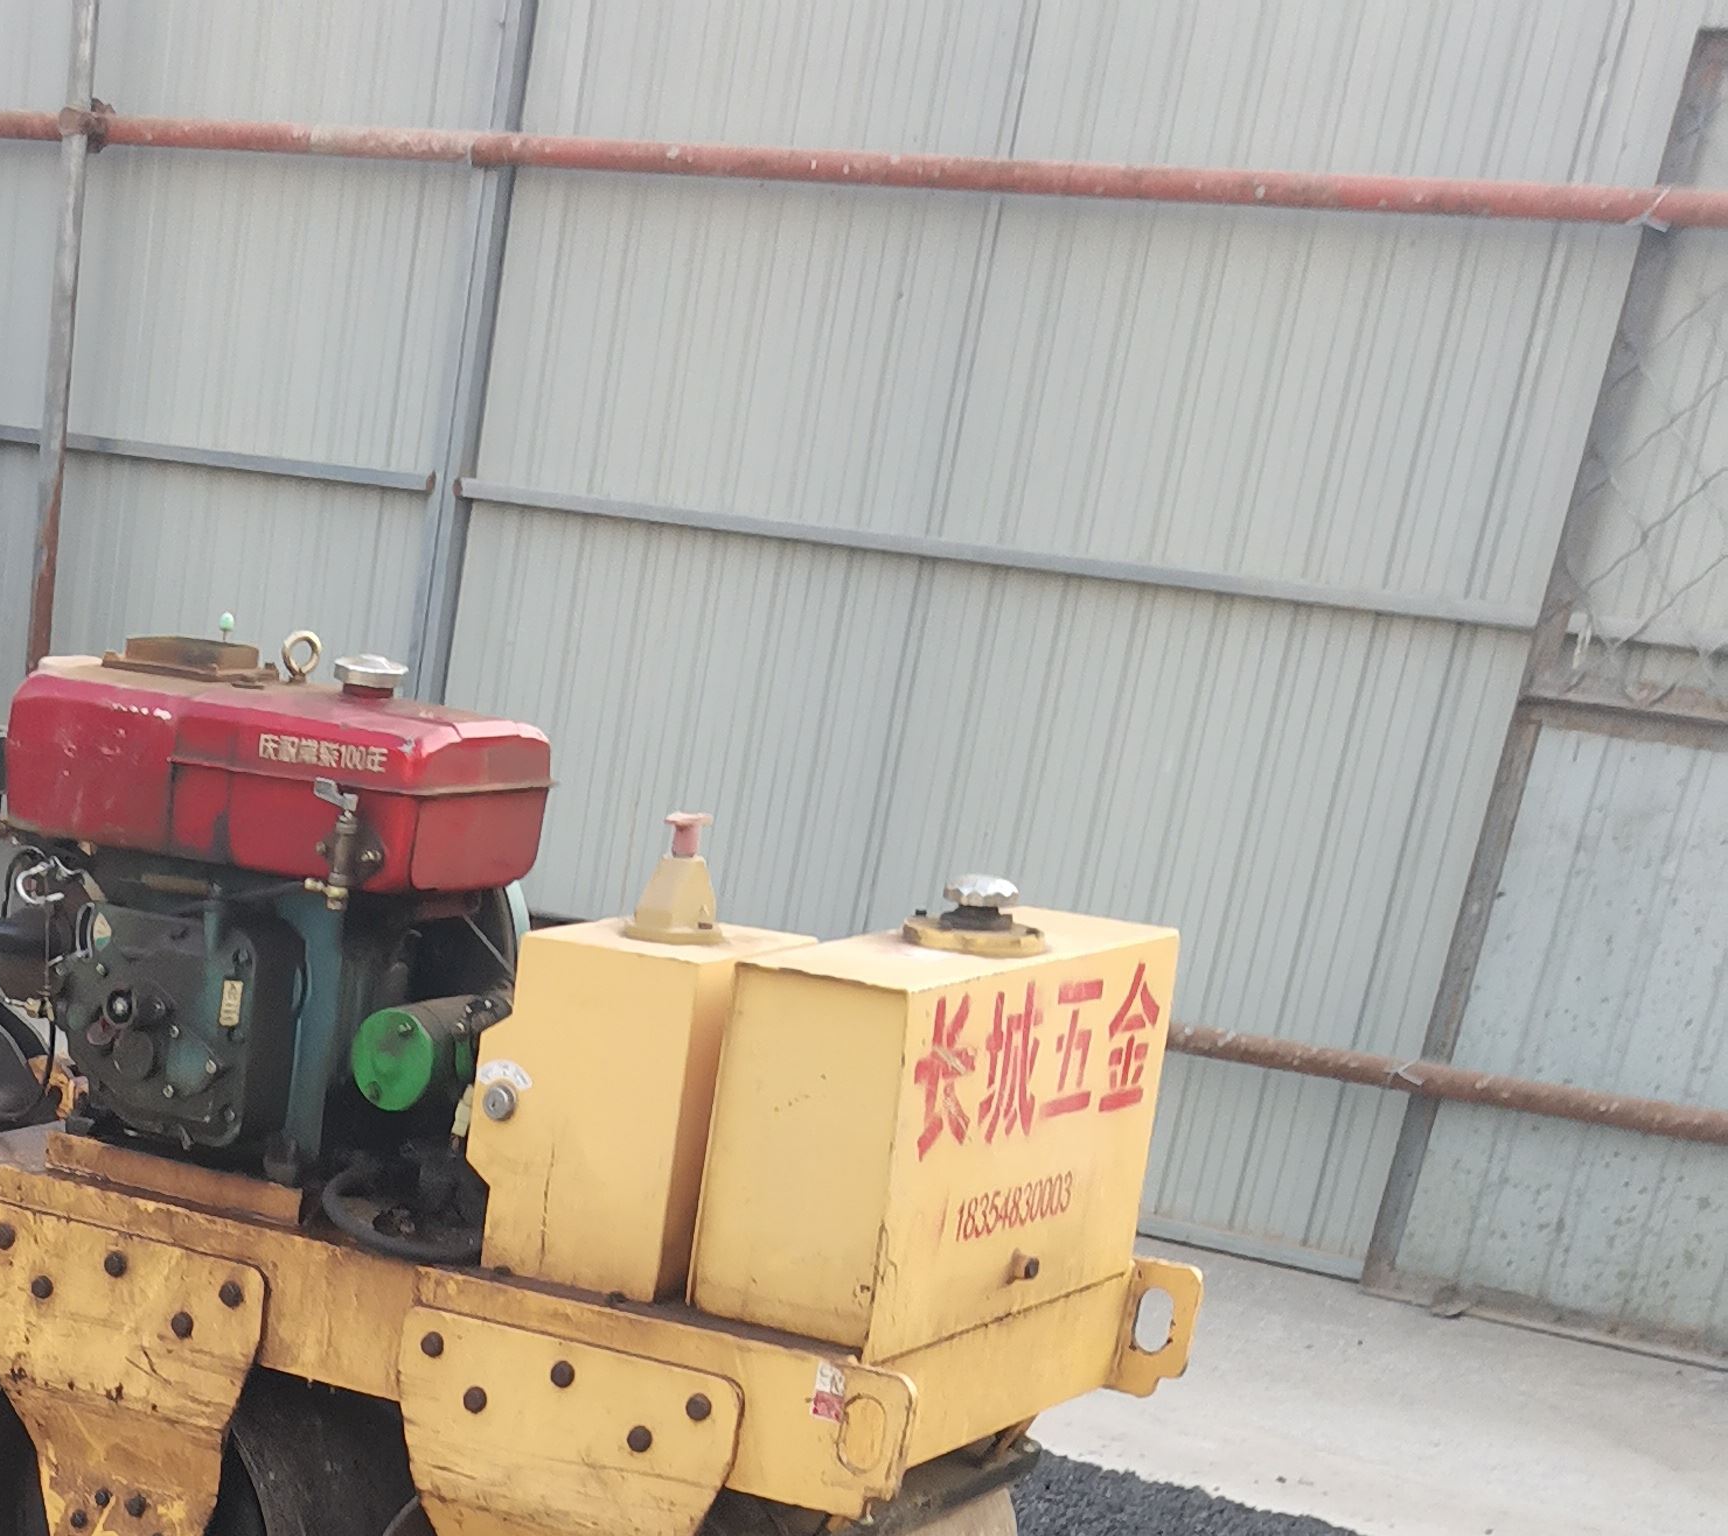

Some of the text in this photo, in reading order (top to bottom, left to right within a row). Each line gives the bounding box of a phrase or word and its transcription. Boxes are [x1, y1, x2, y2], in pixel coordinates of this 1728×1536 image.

[914, 962, 1160, 1162] 长城五金
[956, 1171, 1073, 1243] 18354830003
